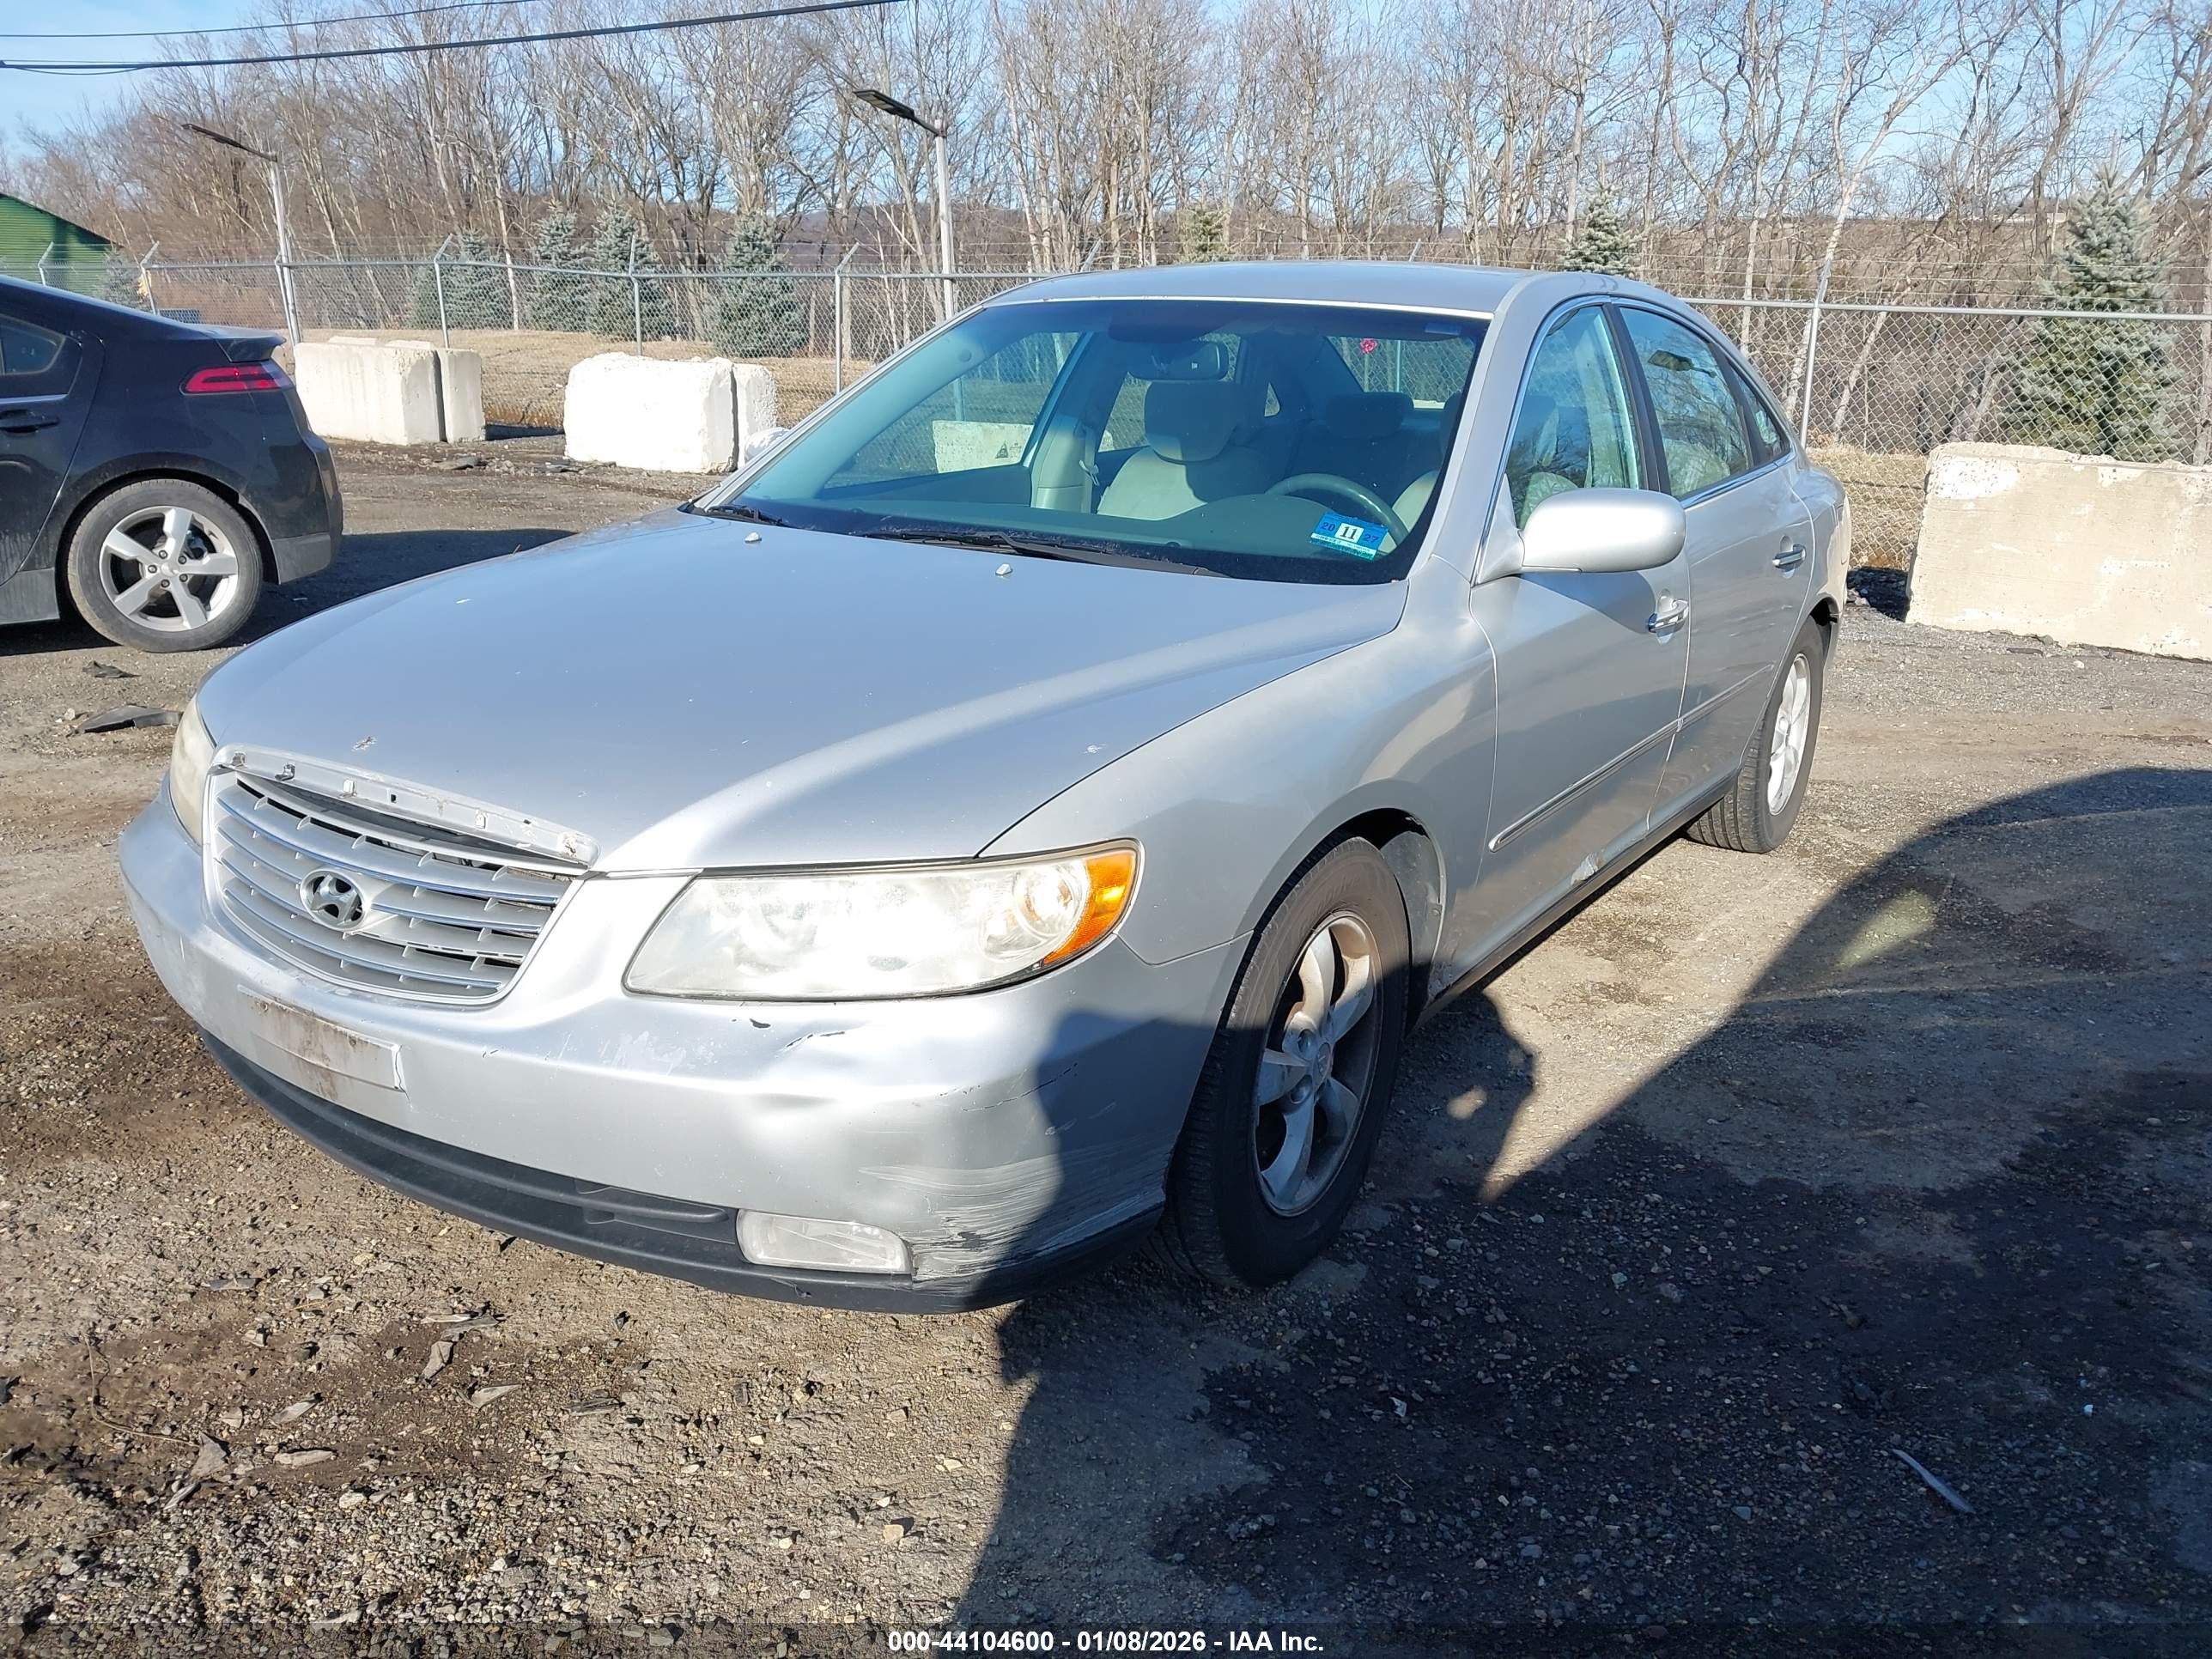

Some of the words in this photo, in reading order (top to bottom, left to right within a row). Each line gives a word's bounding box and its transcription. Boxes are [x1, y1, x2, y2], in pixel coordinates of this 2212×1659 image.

[1321, 522, 1336, 532] 20
[1340, 526, 1358, 540] 11
[1363, 533, 1379, 544] 27
